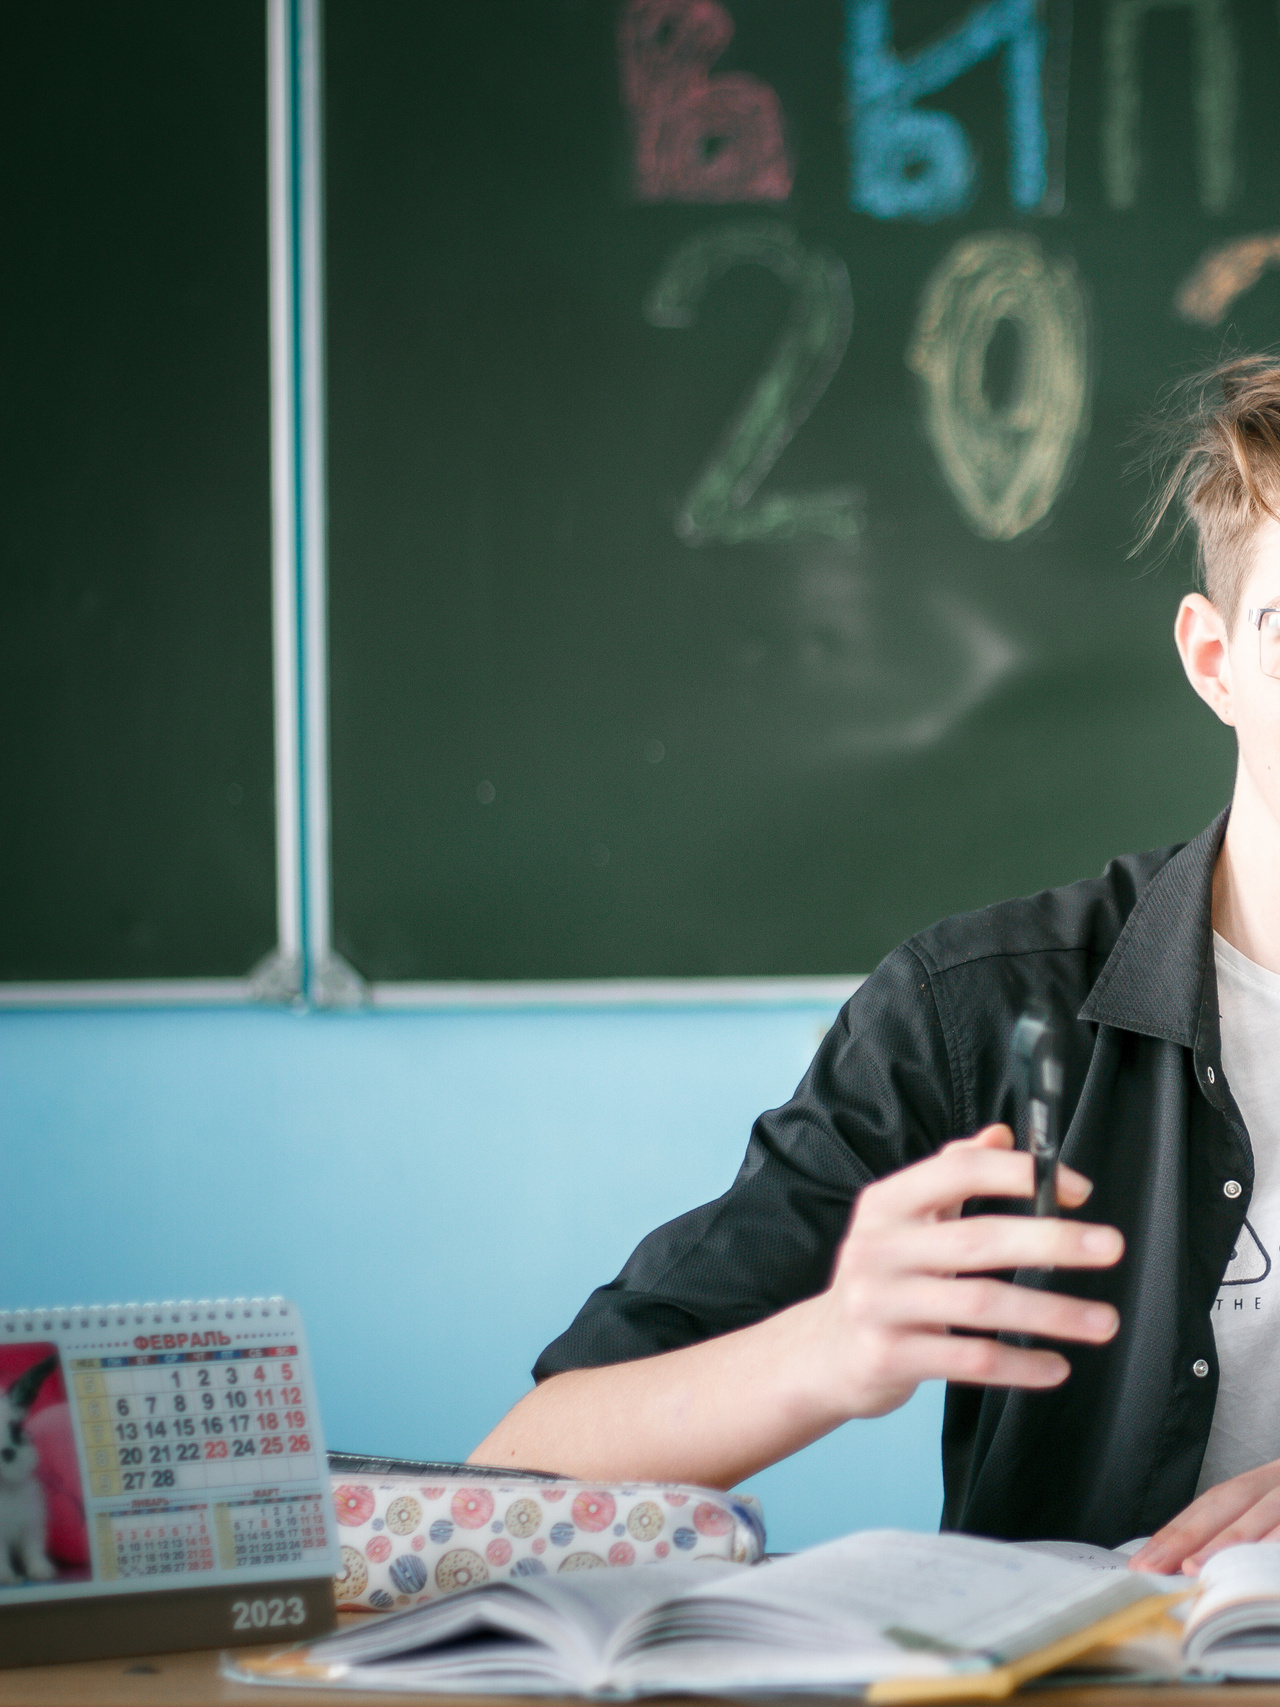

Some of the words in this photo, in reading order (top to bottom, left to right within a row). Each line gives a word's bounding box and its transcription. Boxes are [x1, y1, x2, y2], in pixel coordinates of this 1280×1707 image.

[1216, 1297, 1262, 1311] THE
[134, 1331, 231, 1350] ФЕВРАЛЬ
[171, 1371, 180, 1388] 1
[198, 1370, 210, 1386] 2
[226, 1368, 238, 1384] 3
[254, 1366, 266, 1382] 4
[281, 1364, 293, 1380] 5
[117, 1399, 129, 1416] 6
[145, 1397, 156, 1414] 7
[174, 1395, 186, 1412] 8
[202, 1393, 214, 1410] 9
[226, 1391, 246, 1408] 10
[255, 1389, 273, 1406] 11
[281, 1387, 302, 1404] 12
[116, 1422, 138, 1441] 13
[145, 1421, 166, 1438] 14
[173, 1419, 194, 1436] 15
[202, 1417, 223, 1434] 16
[230, 1415, 250, 1432] 17
[257, 1413, 278, 1430] 18
[285, 1411, 305, 1428] 19
[120, 1448, 142, 1465] 20
[150, 1446, 171, 1463] 21
[177, 1443, 200, 1461] 22
[205, 1441, 227, 1459] 23
[233, 1439, 255, 1457] 24
[260, 1437, 283, 1454] 25
[288, 1435, 310, 1453] 26
[123, 1472, 145, 1490] 27
[152, 1470, 175, 1487] 28
[253, 1488, 279, 1498] МАРТ
[261, 1508, 265, 1516] 1
[273, 1507, 279, 1515] 2
[287, 1506, 292, 1514] 3
[300, 1504, 306, 1512] 4
[248, 1521, 253, 1529] 7
[300, 1516, 310, 1524] 11
[313, 1515, 323, 1523] 12
[187, 1526, 192, 1535] 7
[234, 1534, 244, 1542] 13
[260, 1531, 271, 1539] 15
[288, 1529, 298, 1537] 17
[130, 1543, 140, 1551] 10
[144, 1542, 154, 1550] 11
[158, 1541, 168, 1549] 12
[186, 1538, 196, 1547] 14
[249, 1544, 259, 1553] 21
[262, 1543, 273, 1551] 22
[275, 1542, 286, 1550] 23
[289, 1541, 300, 1549] 24
[236, 1557, 246, 1566] 27
[291, 1552, 302, 1561] 31
[146, 1566, 157, 1574] 25
[174, 1563, 185, 1572] 27
[232, 1597, 305, 1630] 2023
